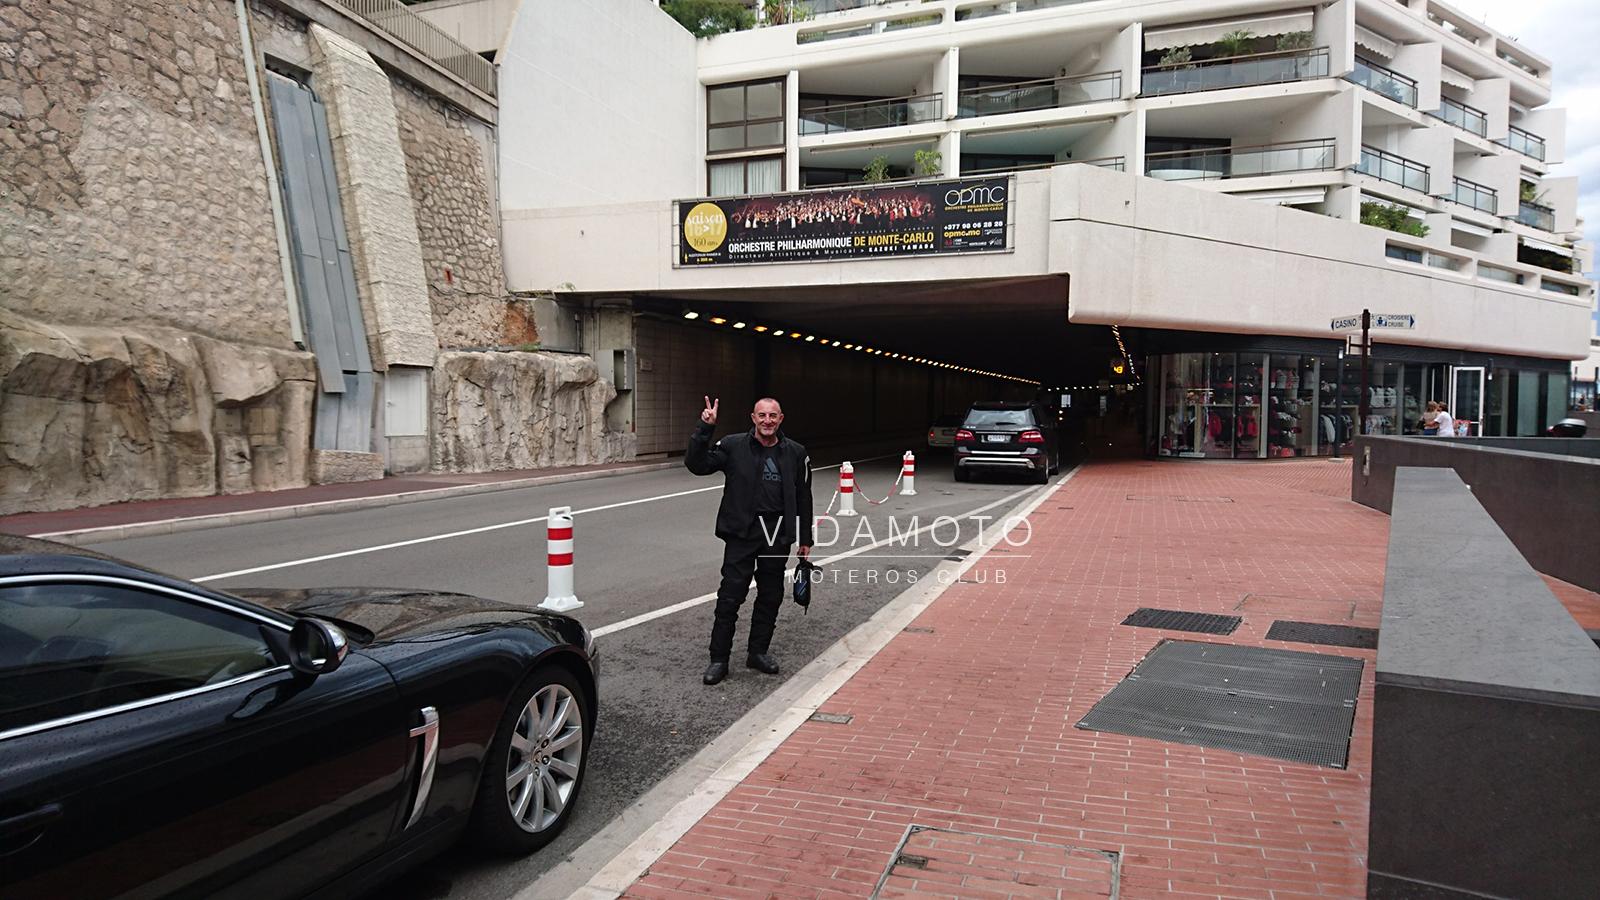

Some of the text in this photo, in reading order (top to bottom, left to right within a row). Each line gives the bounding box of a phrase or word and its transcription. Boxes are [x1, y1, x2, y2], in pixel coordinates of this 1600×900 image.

[944, 229, 981, 239] opmc.mc
[728, 241, 776, 253] ORCHESTRE
[777, 237, 852, 250] PHILHARMONIQUE
[854, 236, 866, 247] DE
[868, 231, 934, 246] MONTE-CARLO
[1335, 318, 1357, 329] CASINO
